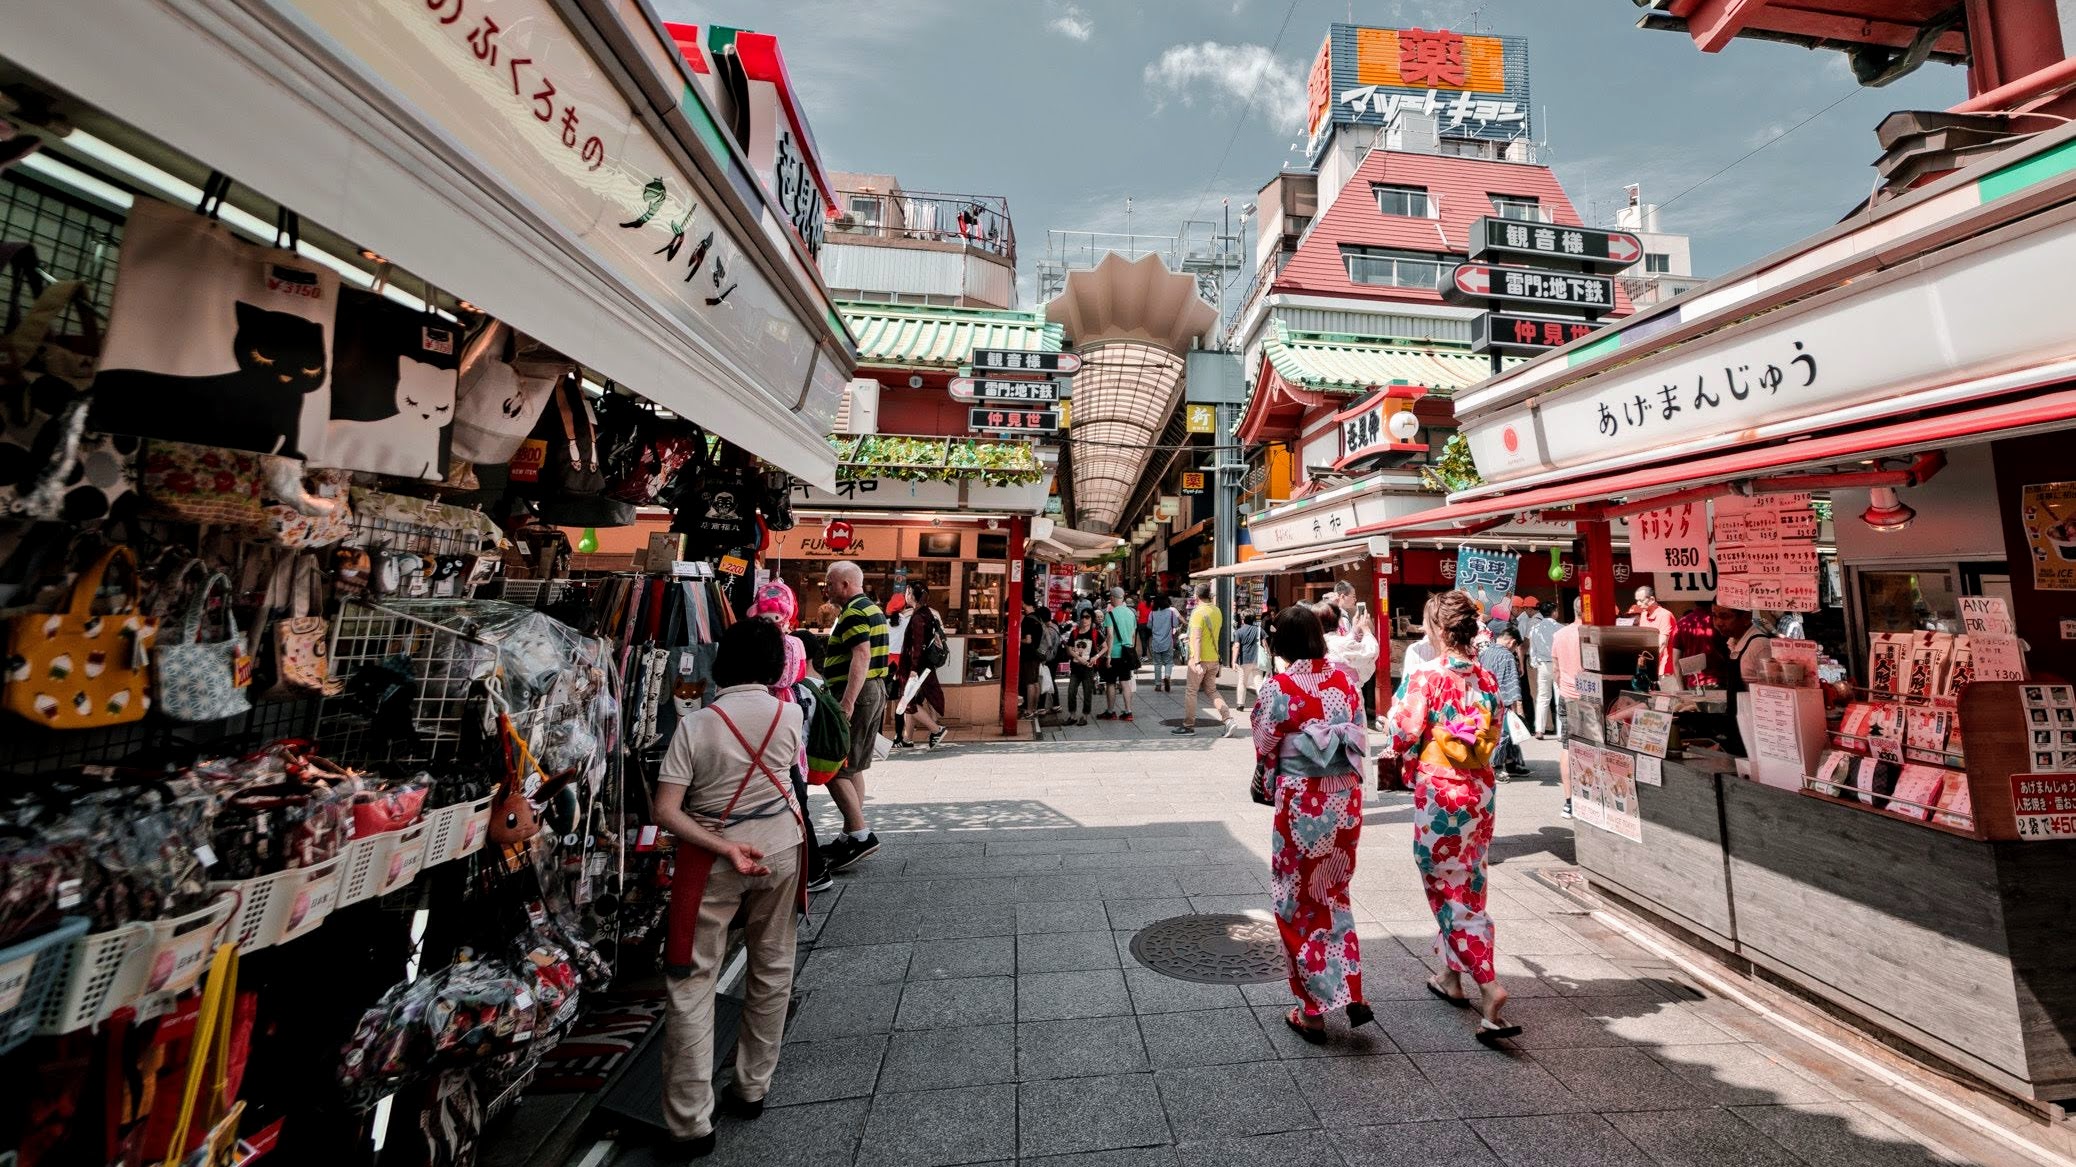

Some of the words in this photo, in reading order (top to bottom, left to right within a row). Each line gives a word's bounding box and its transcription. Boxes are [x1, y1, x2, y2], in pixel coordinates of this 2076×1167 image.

[1397, 26, 1466, 88] 薬
[1507, 225, 1584, 254] 観音様
[987, 352, 1041, 369] 観音様
[1599, 341, 1817, 437] あげまんじゅう
[988, 411, 1041, 428] 仲見世
[1641, 516, 1690, 541] ドリンク
[1665, 547, 1699, 567] ¥350
[1469, 557, 1507, 576] 電球
[2057, 569, 2073, 578] ICE
[1461, 571, 1513, 592] ソーダ
[1963, 599, 1990, 614] ANY
[1966, 618, 1987, 632] FOR
[1995, 669, 2021, 681] ¥300
[2020, 780, 2076, 795] あげまんじゅう
